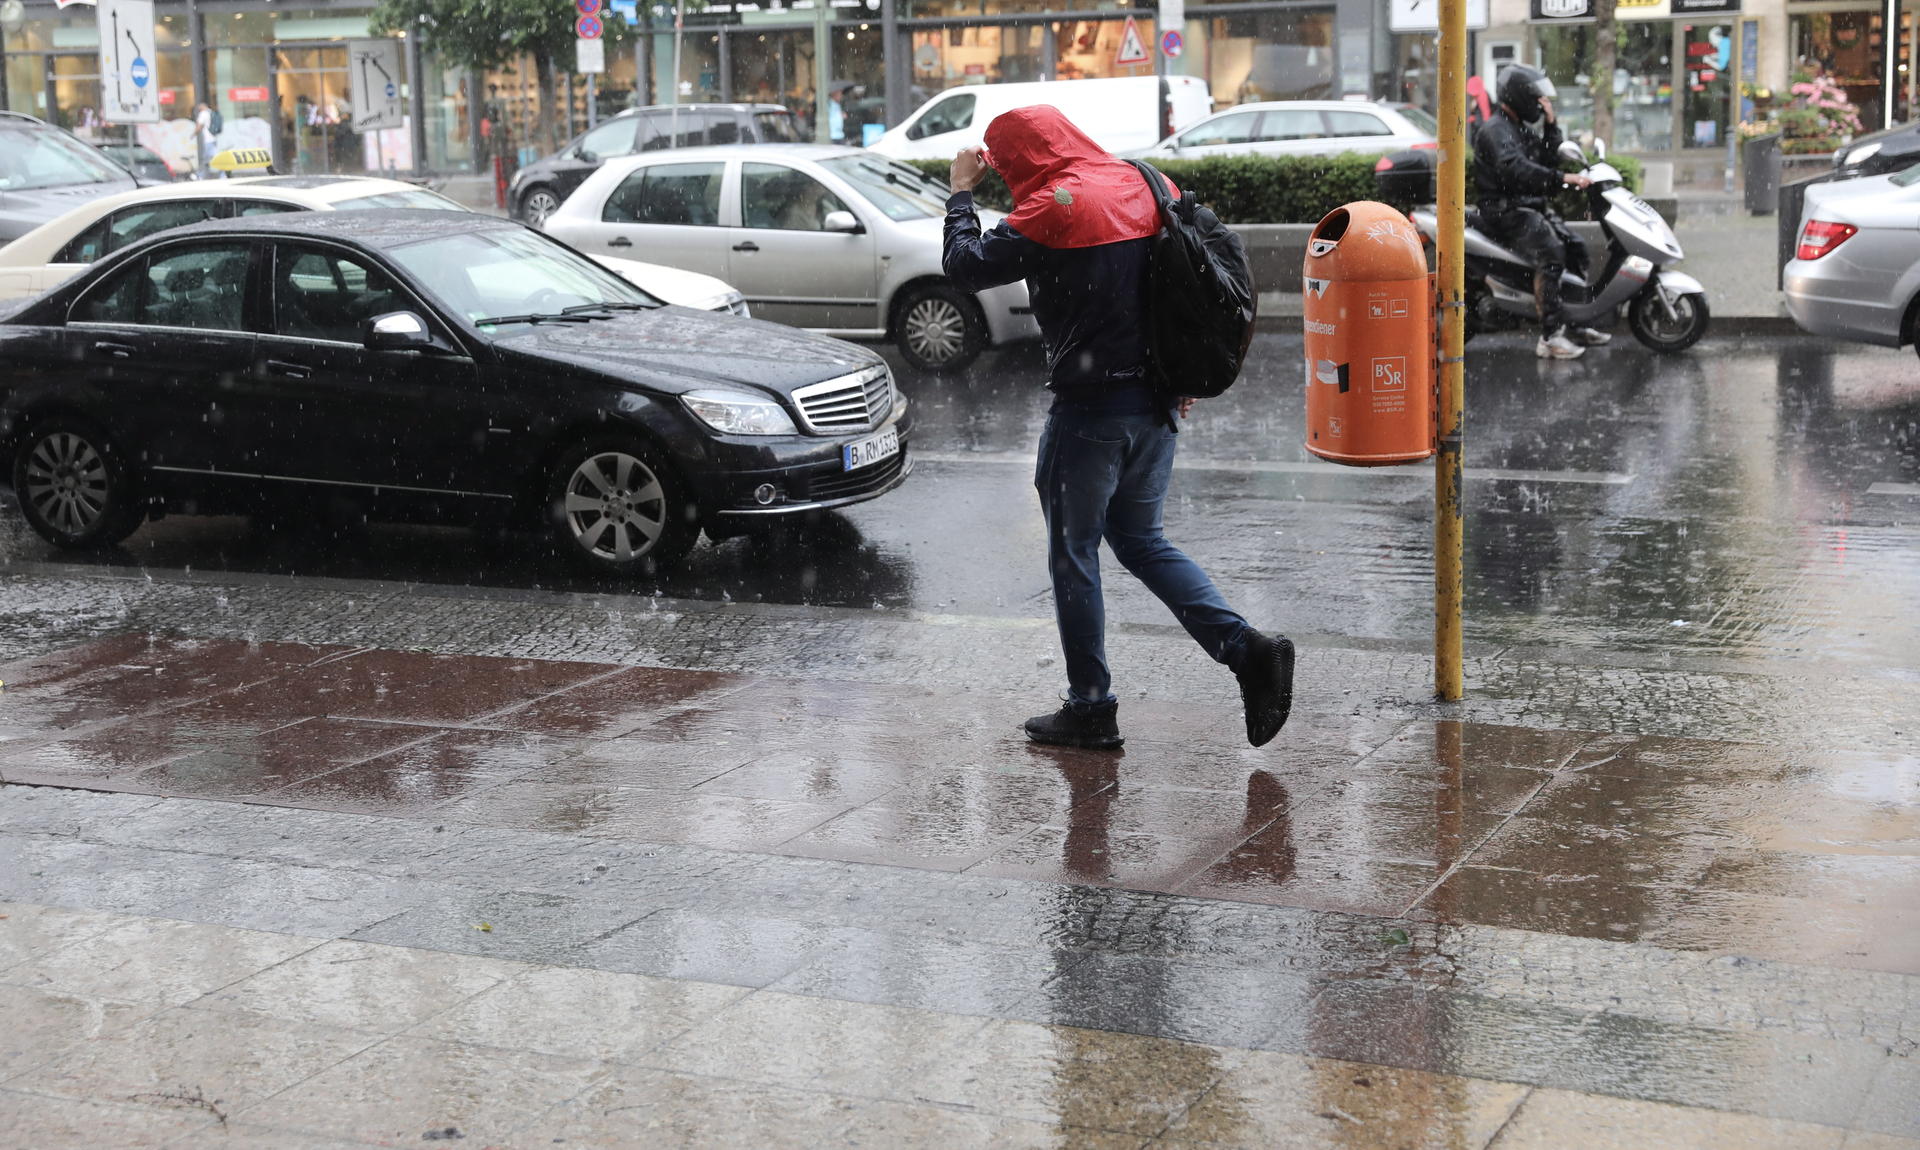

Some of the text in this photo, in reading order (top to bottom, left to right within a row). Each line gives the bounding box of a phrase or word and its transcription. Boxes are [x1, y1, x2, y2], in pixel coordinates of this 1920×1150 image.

[1375, 363, 1402, 386] BSR
[851, 446, 858, 466] B
[866, 441, 879, 461] RM
